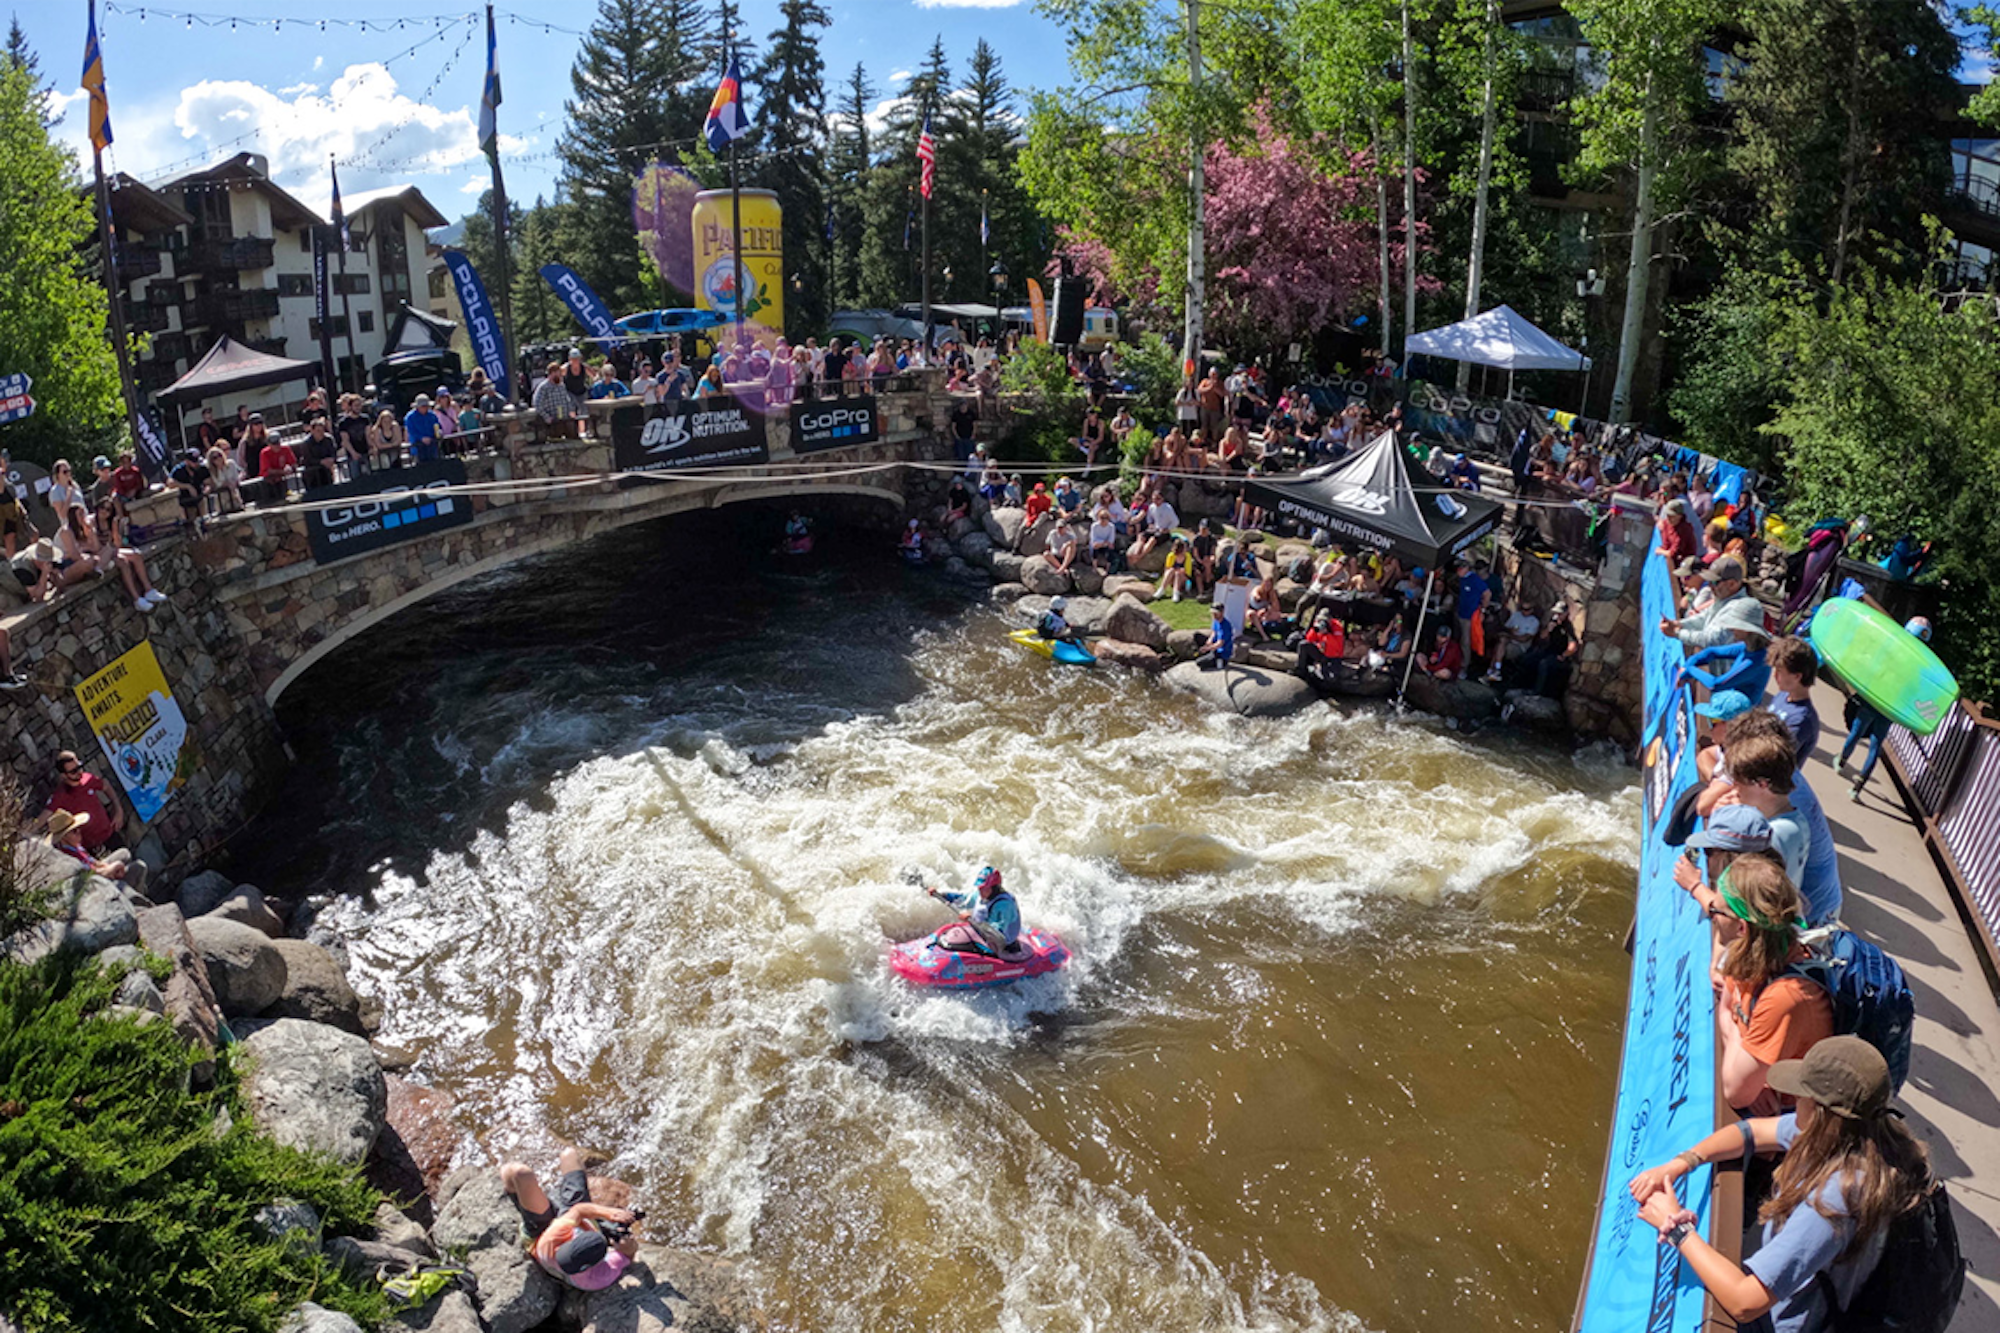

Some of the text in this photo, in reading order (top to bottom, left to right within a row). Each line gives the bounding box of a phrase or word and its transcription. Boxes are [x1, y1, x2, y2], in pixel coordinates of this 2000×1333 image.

[455, 263, 505, 382] POLARIS
[557, 272, 622, 350] POLAR
[640, 409, 742, 449] ON OPTIMUM
[800, 409, 870, 431] GoPro
[320, 479, 450, 527] GoPro
[1278, 499, 1329, 529] OPTIMUM
[349, 520, 382, 537] HERO.
[81, 662, 129, 702] ADVENTURE
[1667, 969, 1691, 1130] TERREX
